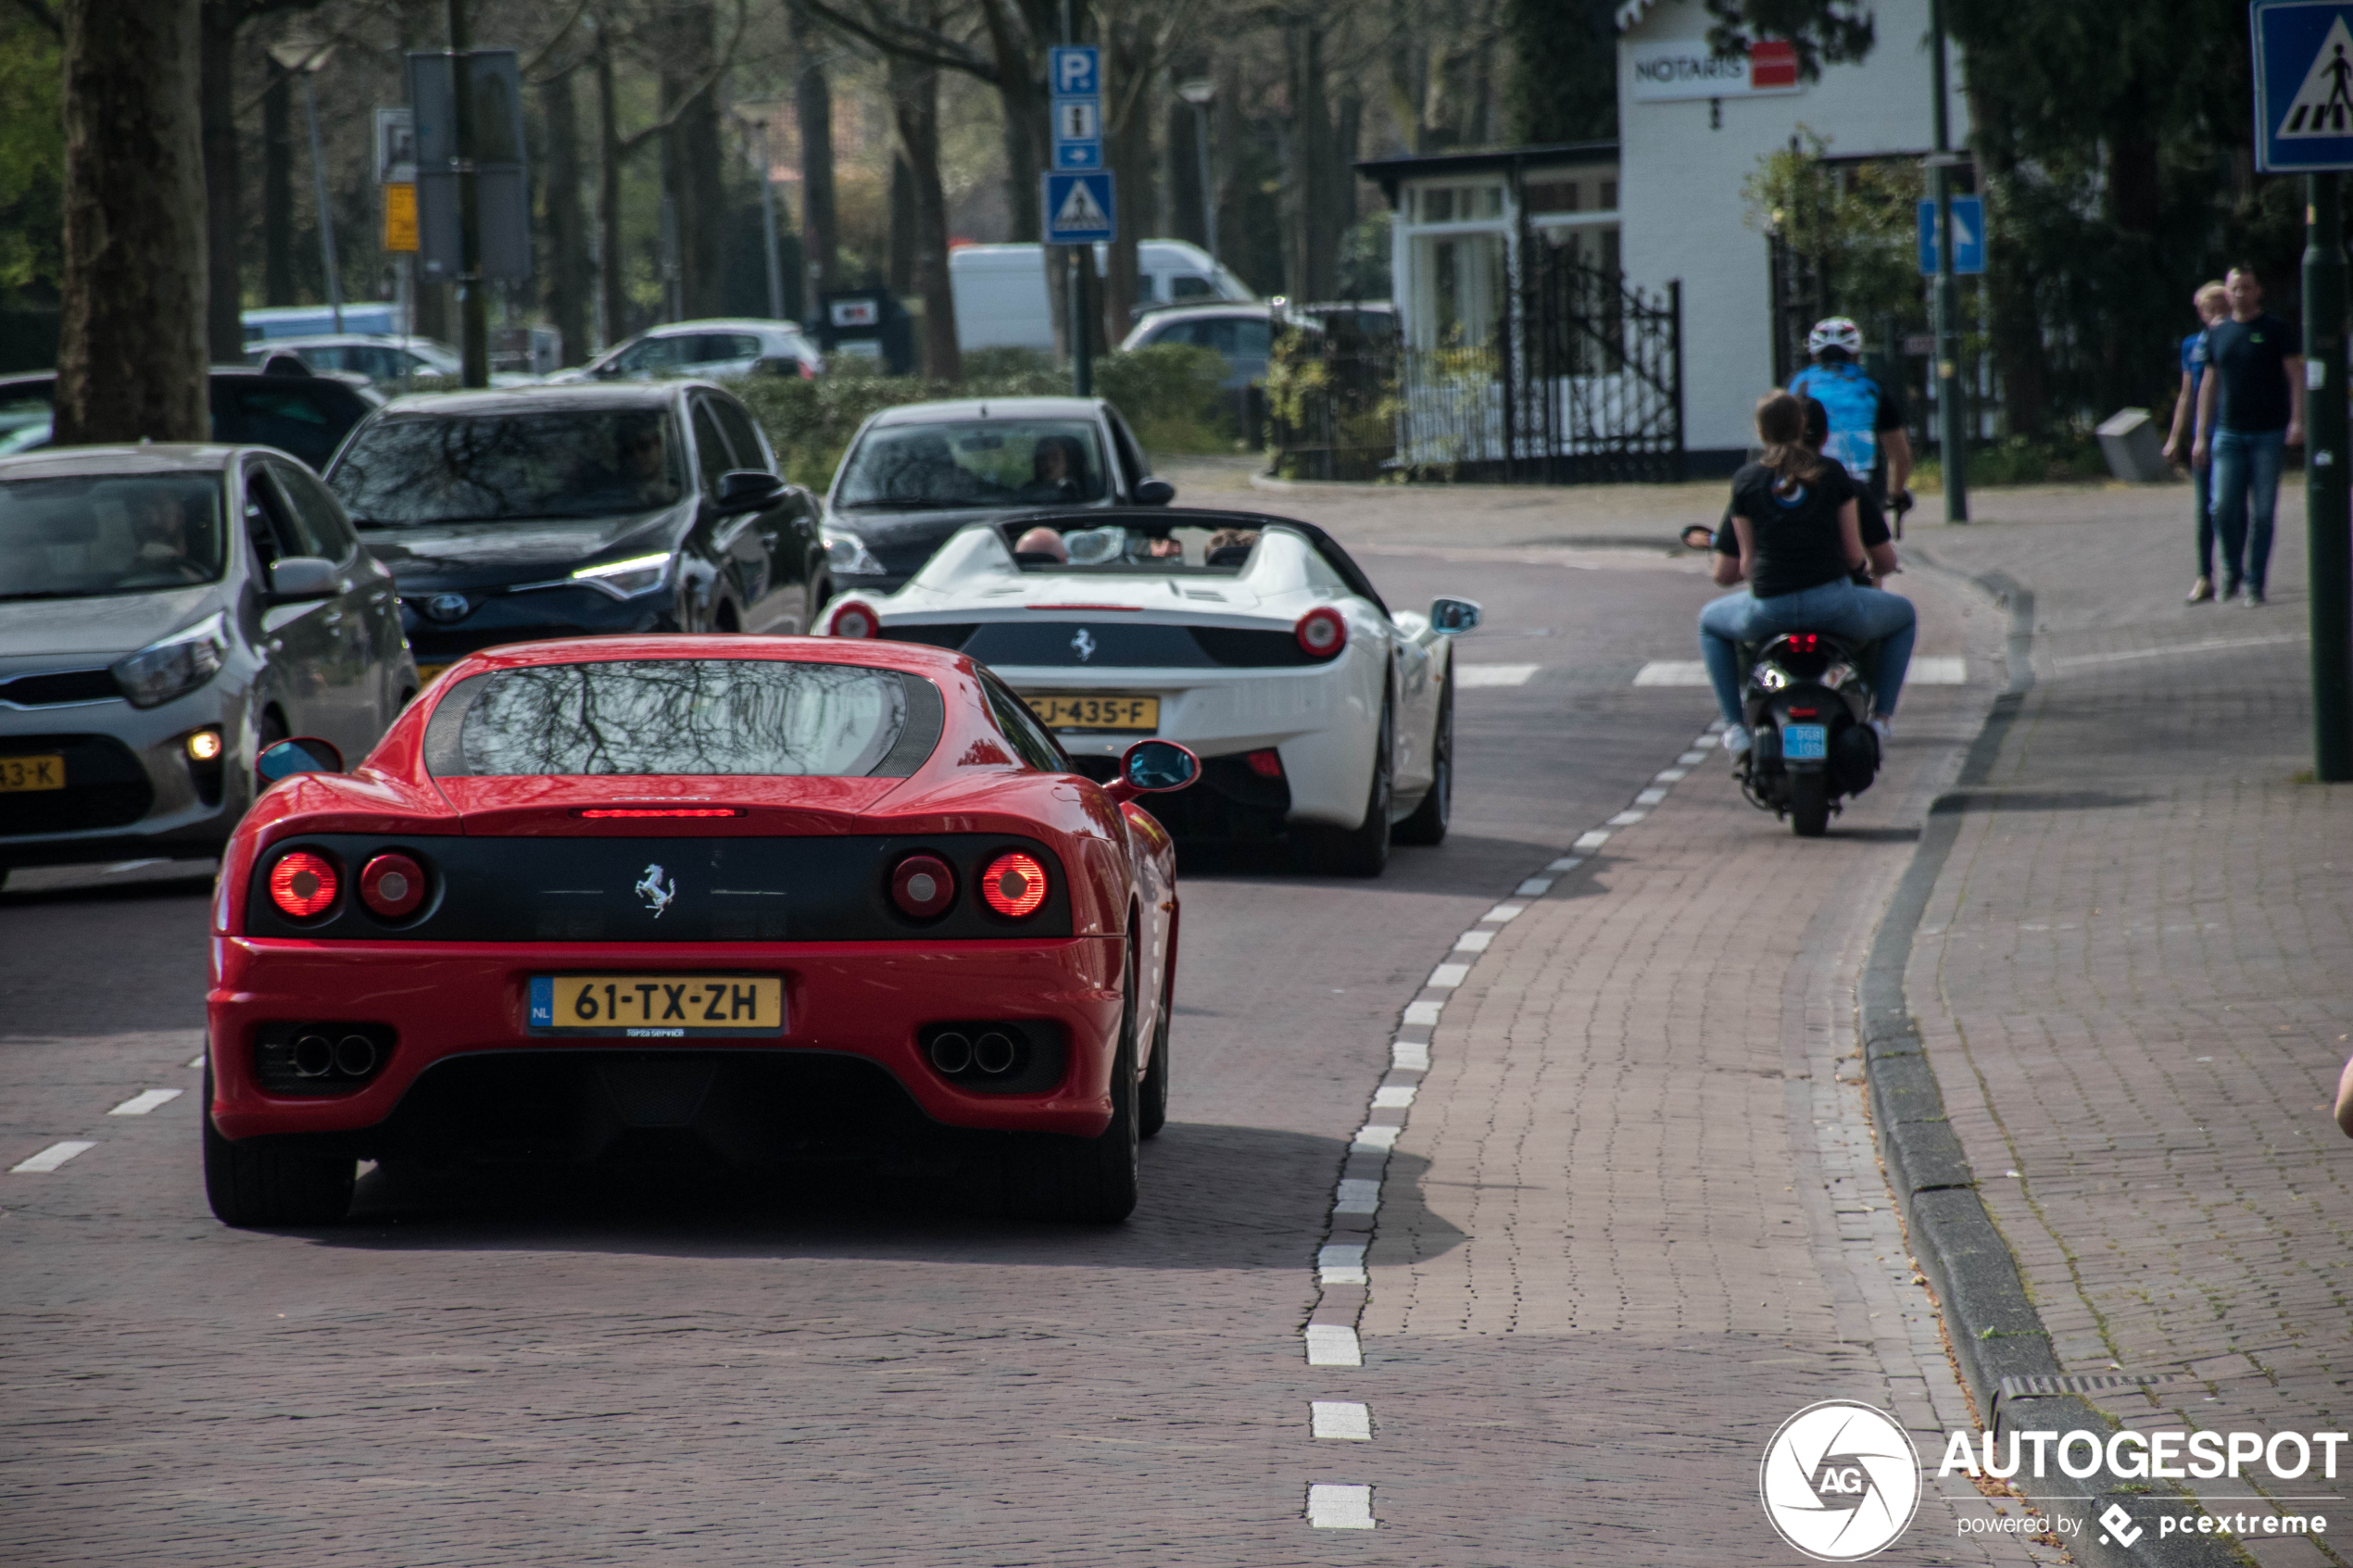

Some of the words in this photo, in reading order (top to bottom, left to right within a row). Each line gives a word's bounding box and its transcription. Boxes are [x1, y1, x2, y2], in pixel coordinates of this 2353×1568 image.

[1059, 53, 1092, 91] P
[1635, 56, 1743, 82] NOTARIS
[532, 1008, 550, 1019] NL
[574, 984, 756, 1020] 61-TX-ZH
